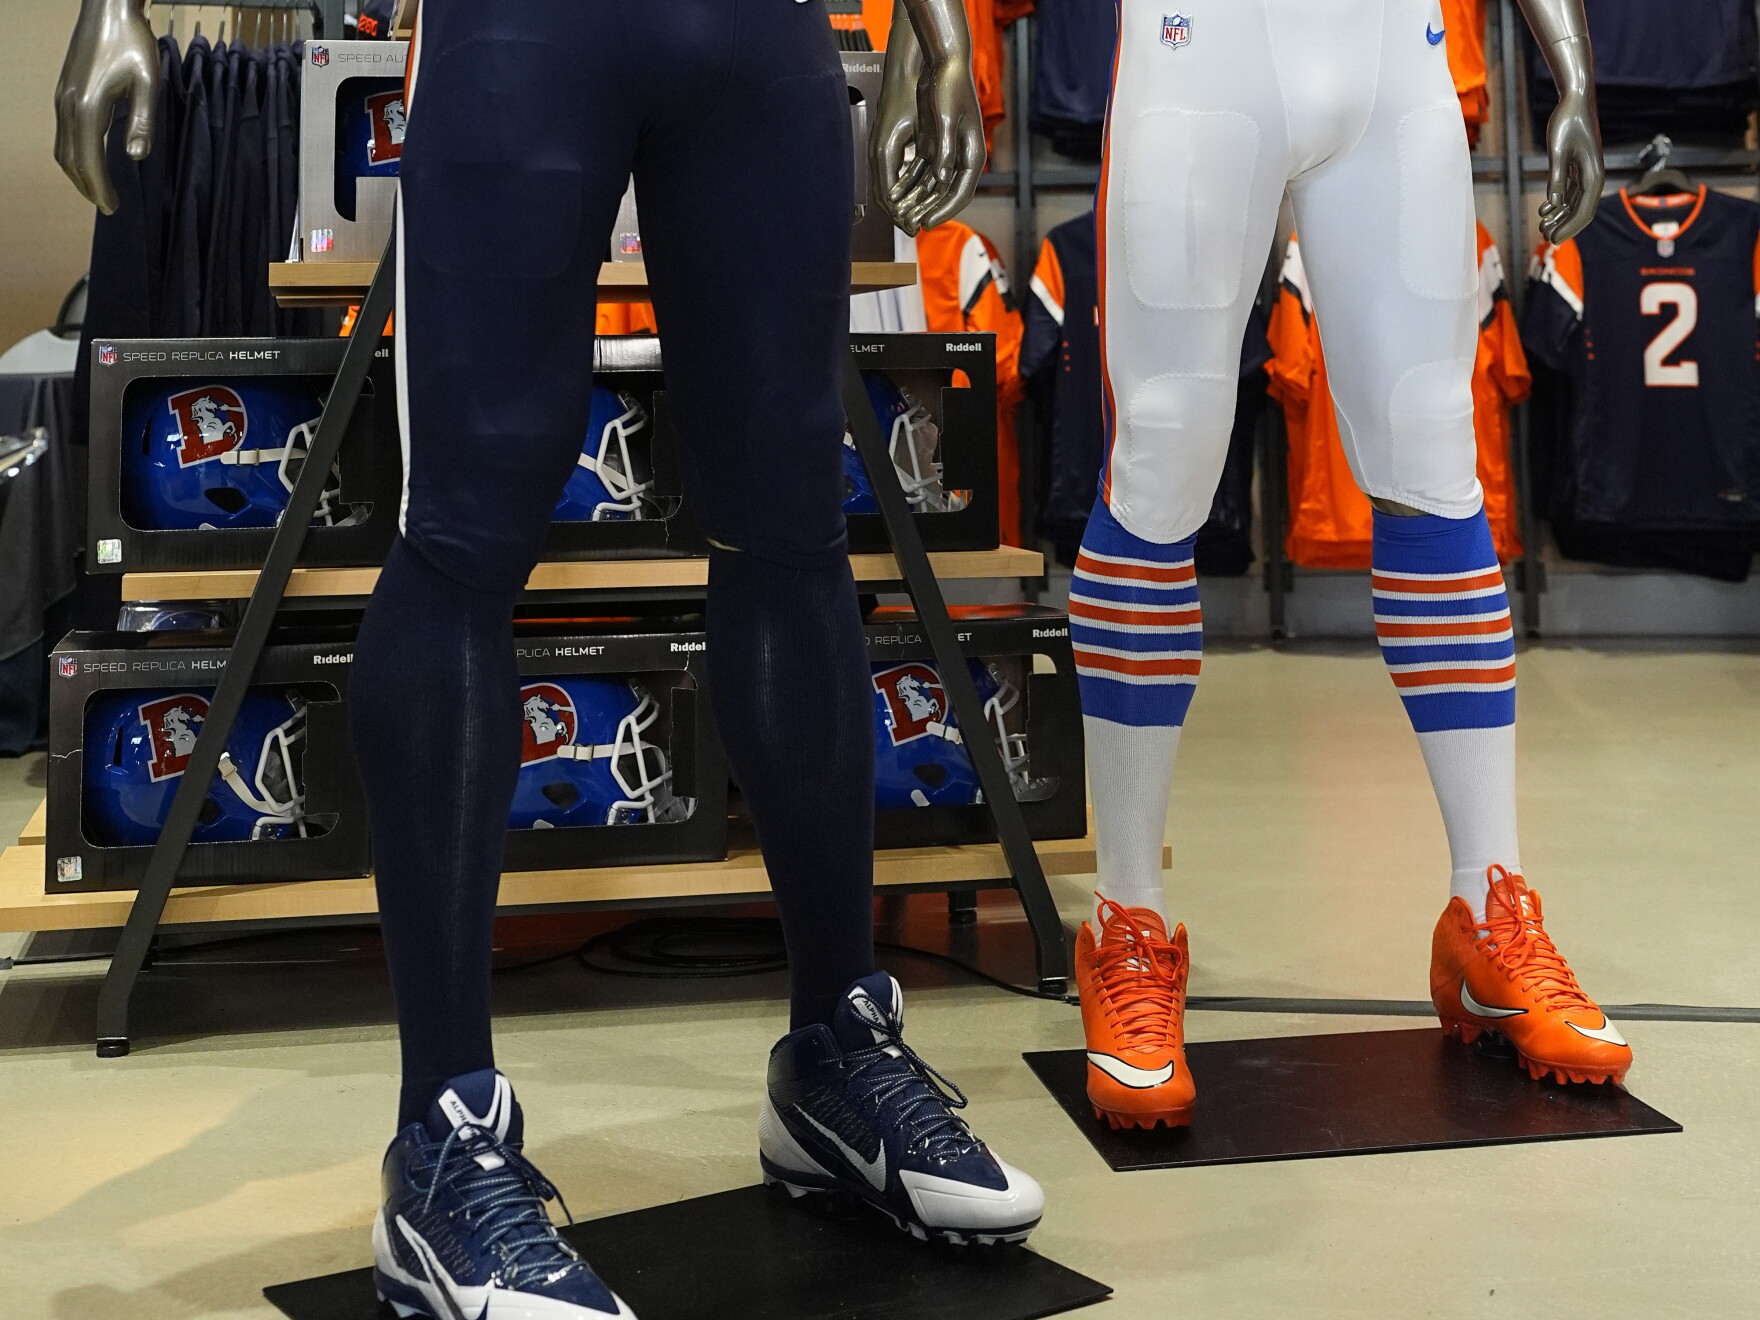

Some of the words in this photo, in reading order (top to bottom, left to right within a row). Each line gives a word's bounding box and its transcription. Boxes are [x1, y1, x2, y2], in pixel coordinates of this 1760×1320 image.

[1165, 27, 1186, 42] NFL
[313, 53, 329, 64] NFL
[337, 53, 382, 63] SPEED
[1639, 281, 1699, 387] 2
[850, 344, 885, 353] ELMET
[945, 342, 982, 352] Riddell
[101, 351, 118, 365] NFL
[123, 352, 167, 362] SPEED
[171, 351, 224, 361] REPLICA
[229, 350, 281, 360] HELMET
[875, 634, 922, 645] REPLICA
[1032, 627, 1069, 638] Riddell
[516, 648, 550, 658] PLICA
[555, 646, 605, 657] HELMET
[670, 642, 706, 652] Riddel
[61, 664, 78, 676] NFL
[83, 662, 127, 673] SPEED
[132, 661, 186, 672] REPLICA
[191, 659, 227, 671] HELM
[863, 1000, 880, 1022] ALPHA
